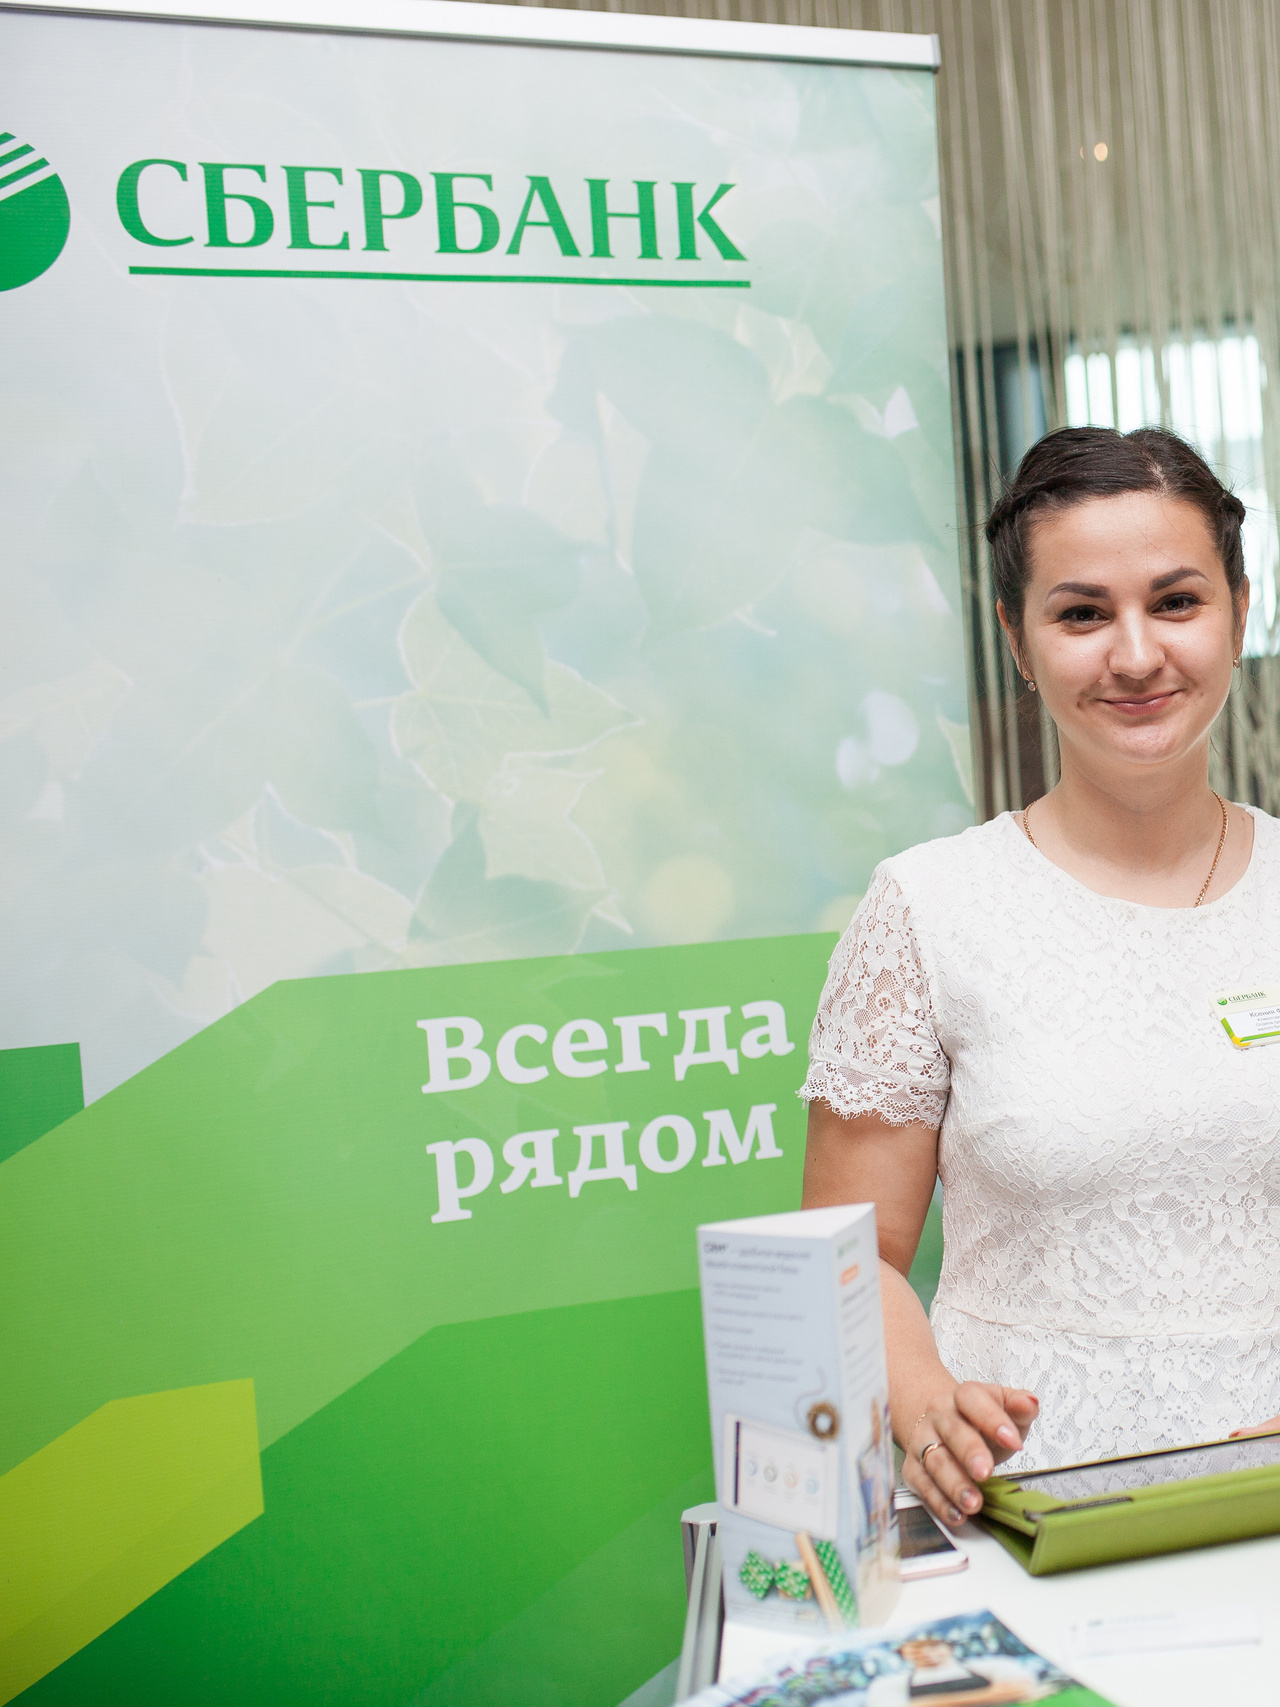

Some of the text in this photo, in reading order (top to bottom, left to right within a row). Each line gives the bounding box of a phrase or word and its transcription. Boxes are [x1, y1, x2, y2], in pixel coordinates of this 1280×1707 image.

[116, 157, 747, 262] СБЕРБАНК
[417, 999, 795, 1094] Всегда
[1228, 991, 1266, 1002] СБЕРБАНК
[426, 1102, 784, 1223] рядом
